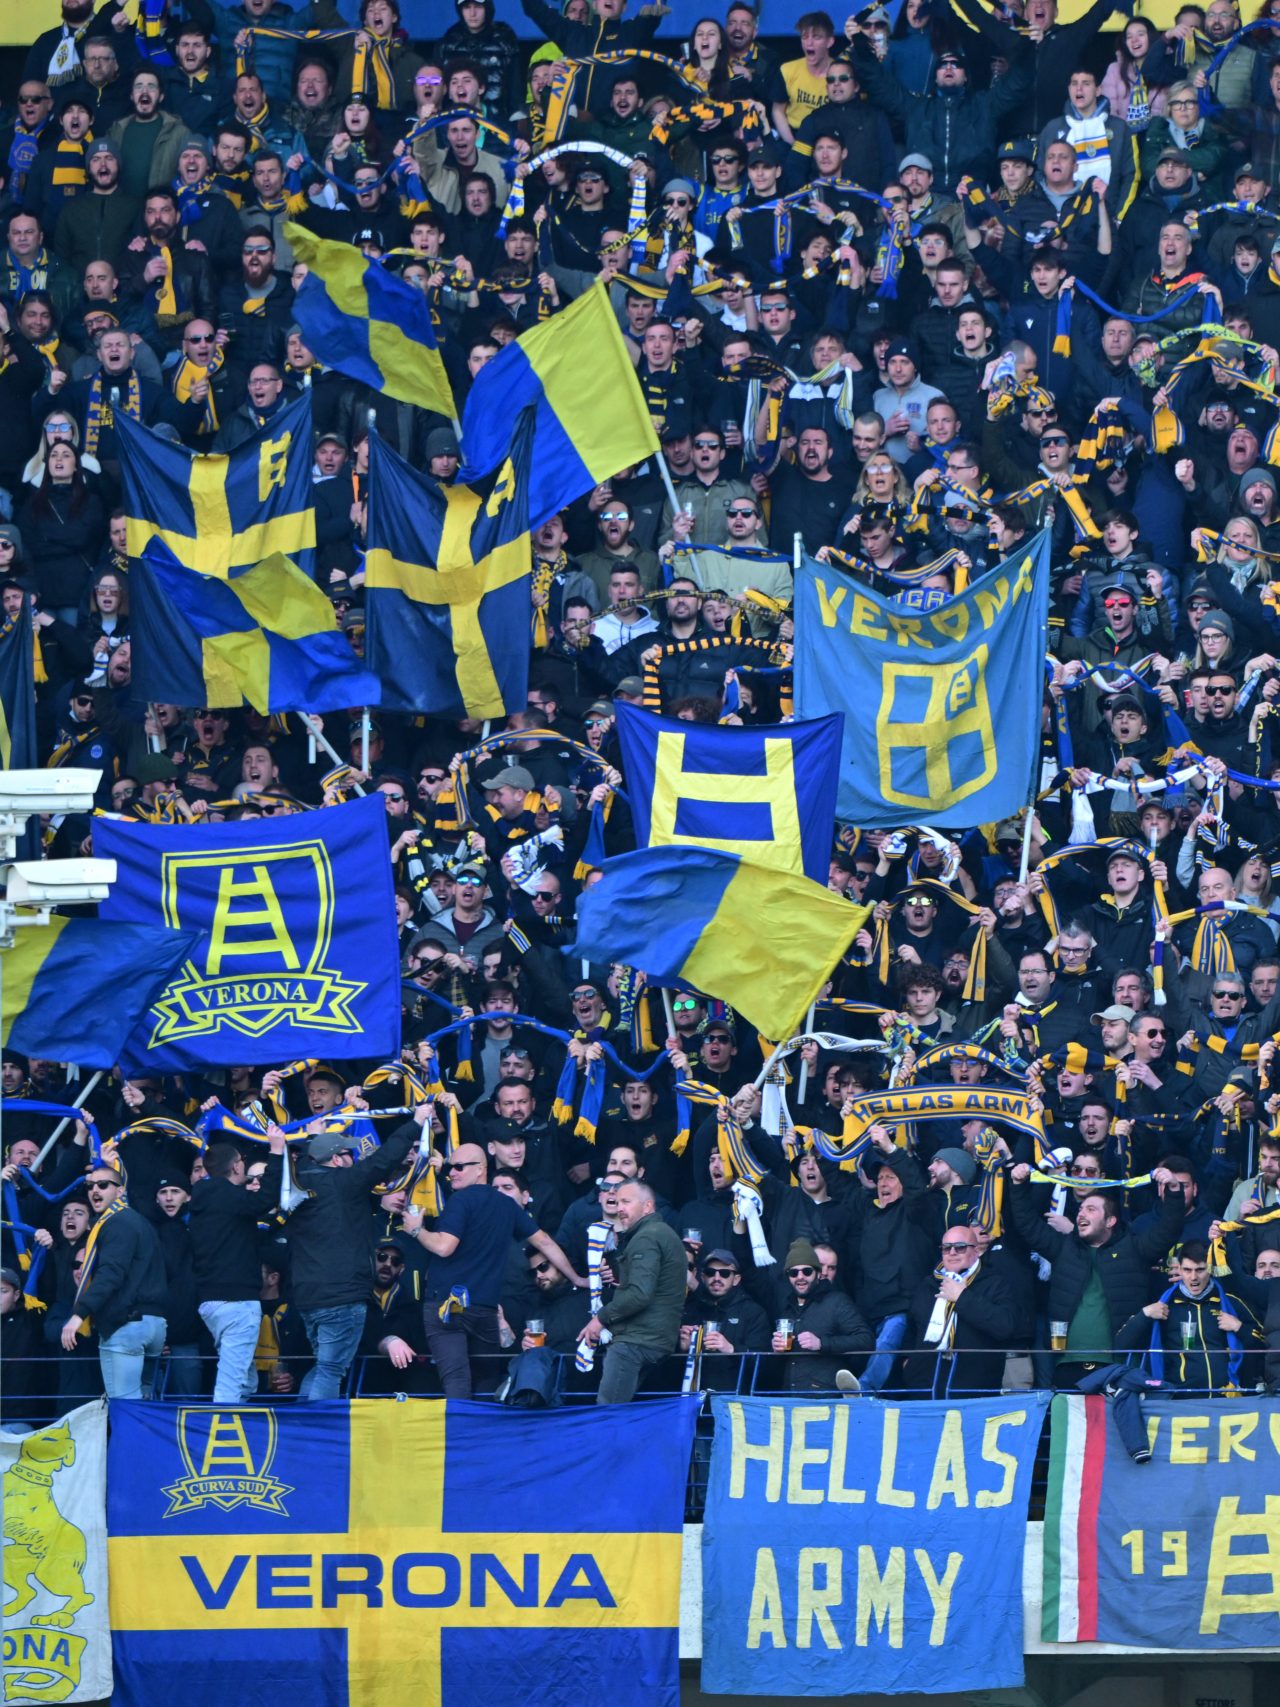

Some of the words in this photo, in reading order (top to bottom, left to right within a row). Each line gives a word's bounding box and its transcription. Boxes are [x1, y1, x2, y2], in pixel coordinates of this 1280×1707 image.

[815, 556, 1033, 648] VERONA
[195, 981, 308, 1008] VERONA
[851, 1094, 954, 1124] HELLAS
[965, 1094, 1037, 1121] ARMY
[728, 1402, 1027, 1510] HELLAS
[189, 1480, 234, 1497] CURVA
[237, 1480, 265, 1496] SUD
[1121, 1529, 1188, 1578] 19
[180, 1552, 618, 1610] VERONA
[746, 1545, 964, 1650] ARMY
[3, 1634, 71, 1667] ONA
